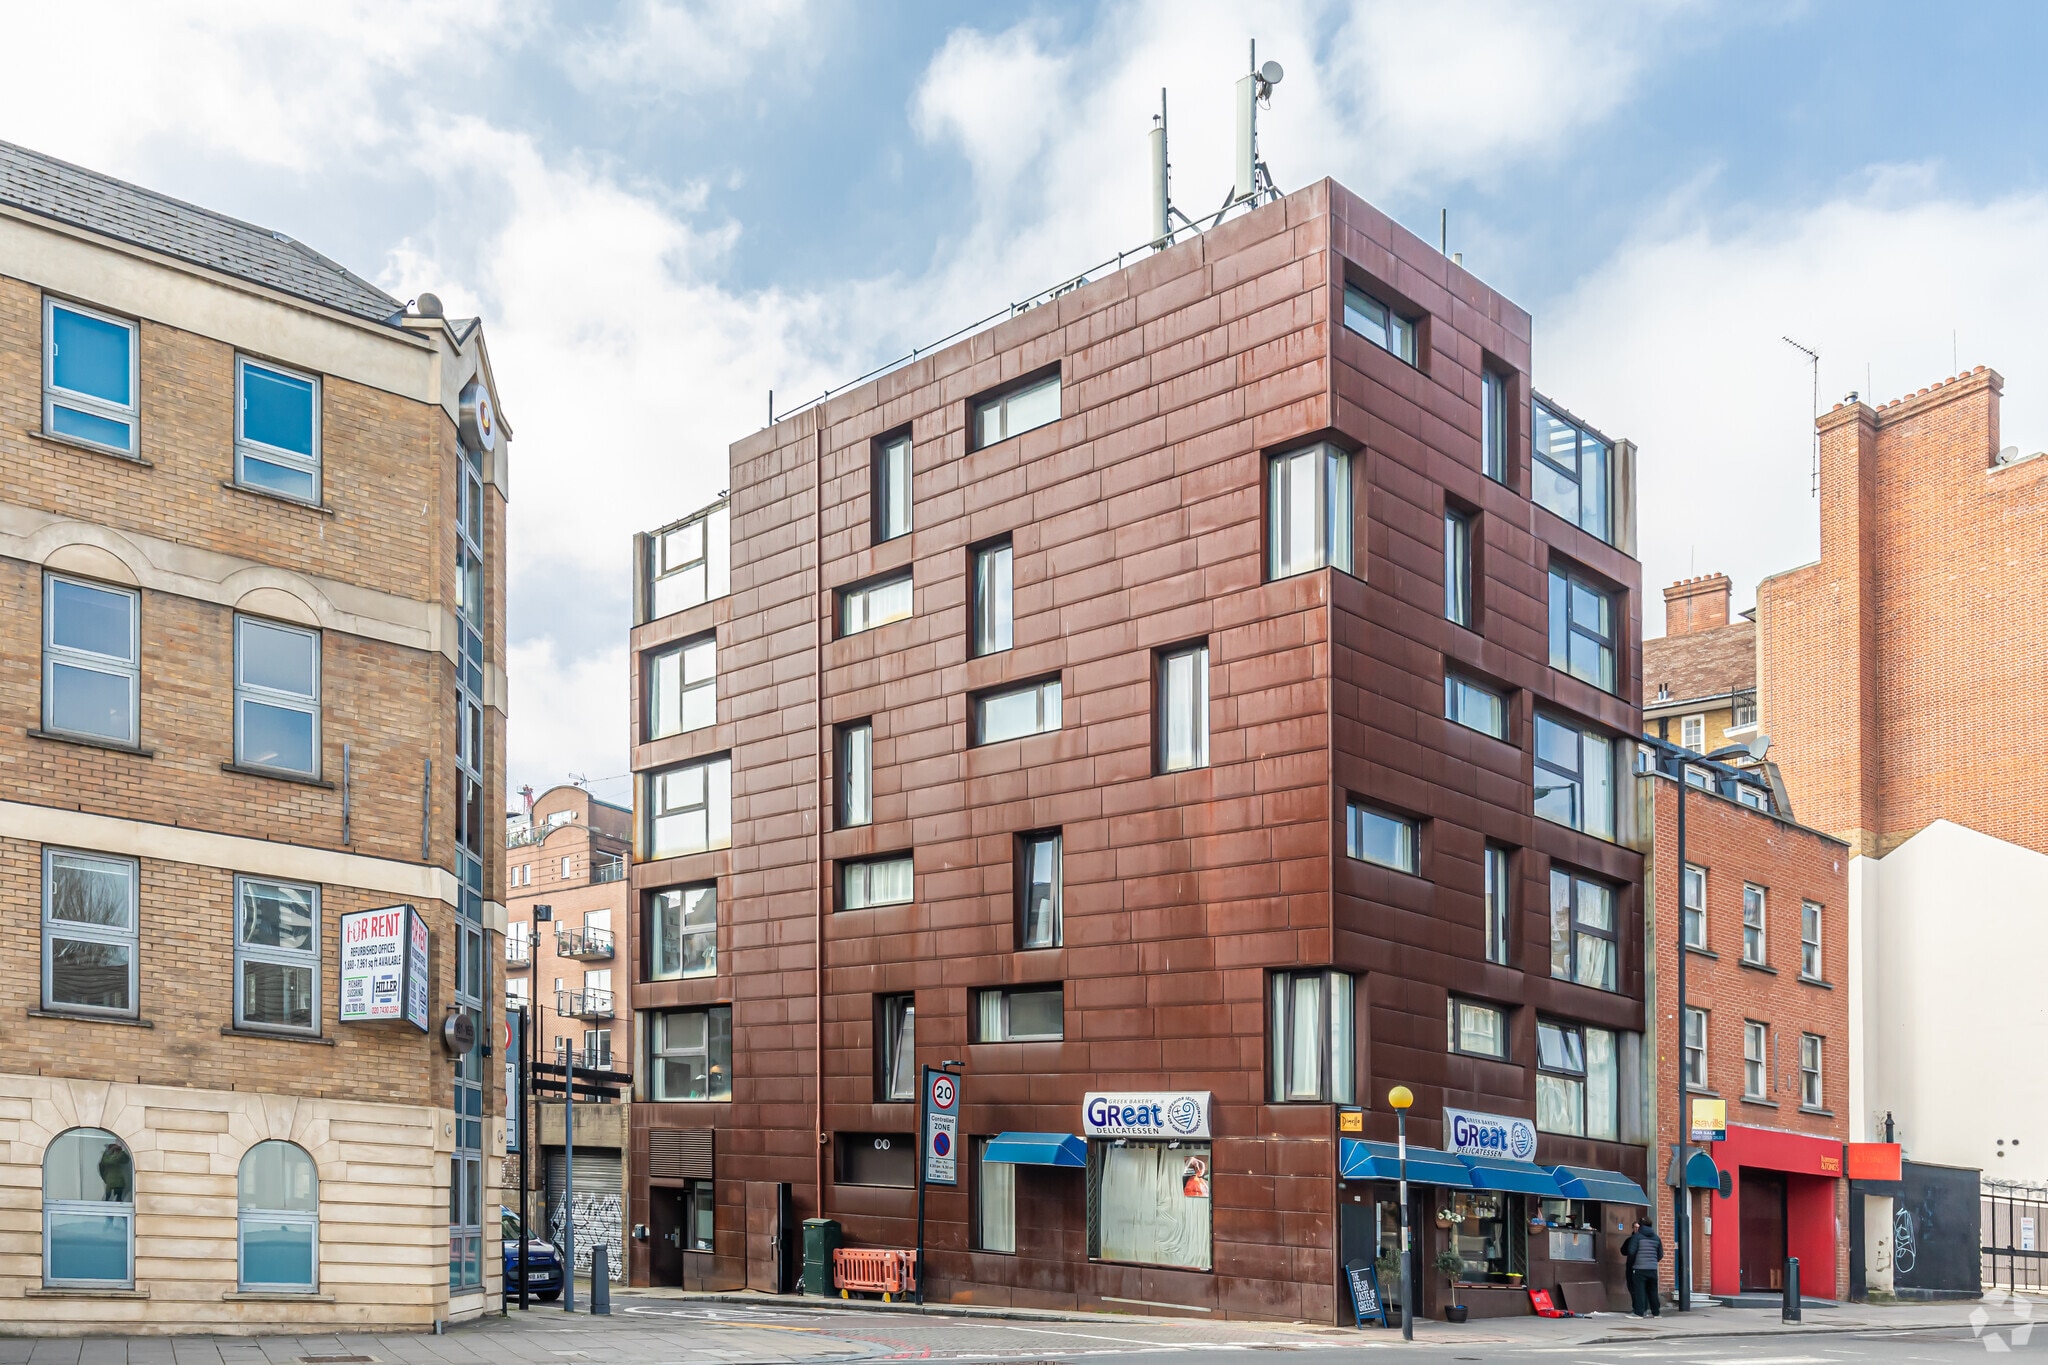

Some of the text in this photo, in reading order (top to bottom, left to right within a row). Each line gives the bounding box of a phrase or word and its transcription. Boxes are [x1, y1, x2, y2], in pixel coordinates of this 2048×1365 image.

[347, 913, 400, 943] FOR RENT
[378, 942, 395, 954] OFFICES
[368, 960, 373, 970] sq
[378, 954, 401, 966] AVAILABLE
[936, 1086, 952, 1099] 20
[931, 1115, 954, 1124] Controlled
[1694, 1118, 1724, 1128] savills
[934, 1123, 951, 1131] ZONE
[1456, 1146, 1503, 1157] DELICATESSEN
[1351, 1272, 1360, 1281] THE
[1353, 1280, 1369, 1292] FRESH
[1356, 1289, 1376, 1301] TASTE OF
[1357, 1299, 1376, 1312] GREECE
